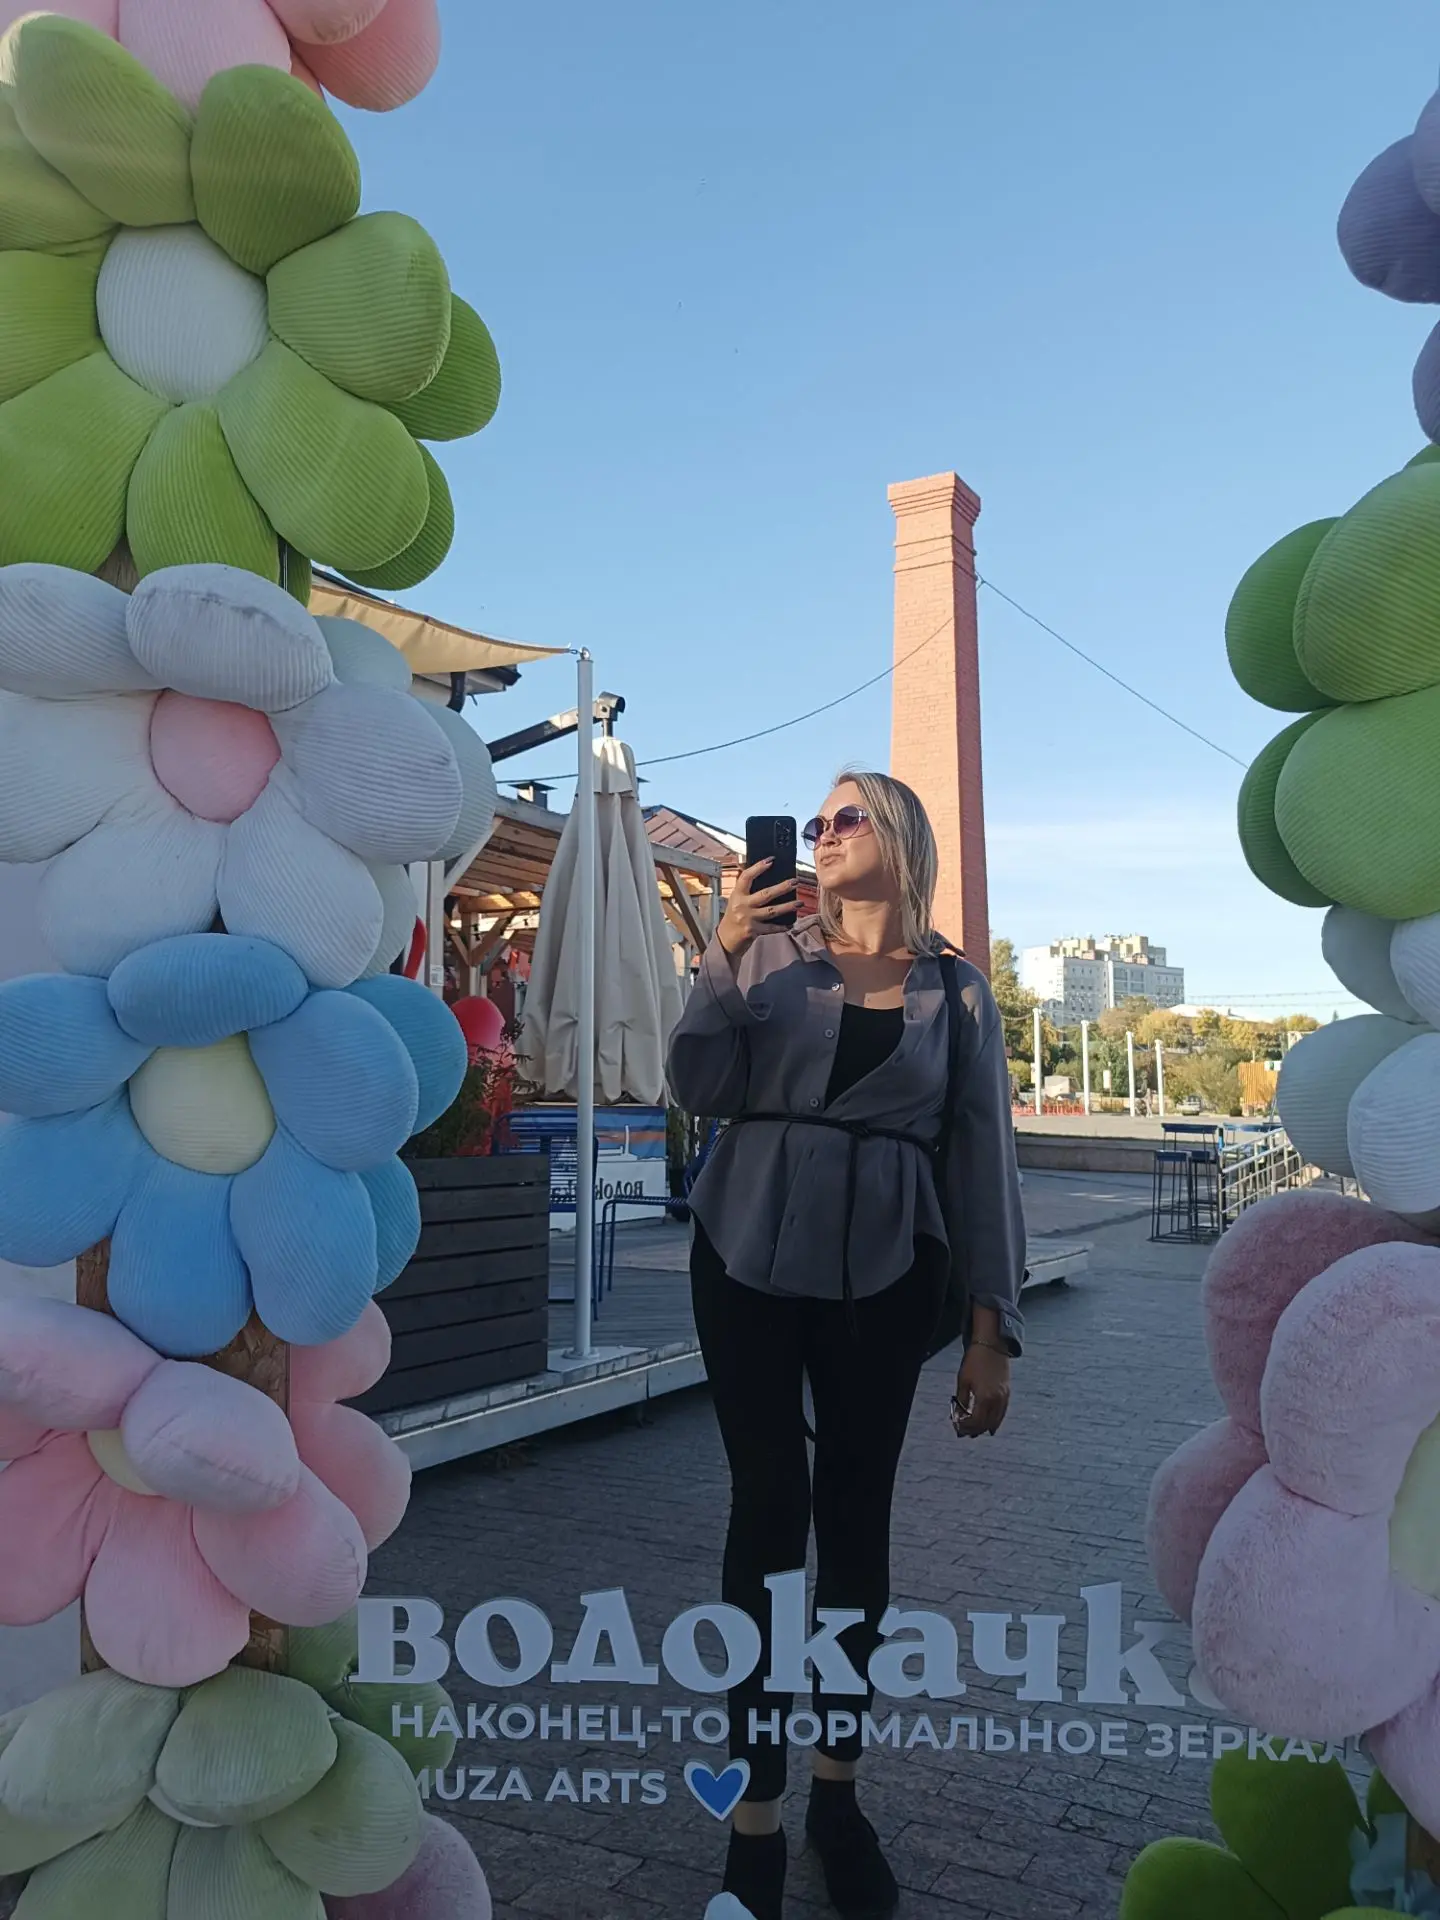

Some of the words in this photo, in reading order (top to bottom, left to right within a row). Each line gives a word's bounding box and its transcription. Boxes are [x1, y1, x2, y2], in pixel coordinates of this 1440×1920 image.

[349, 1568, 1228, 1710] водокачк
[391, 1702, 731, 1749] НАКОНЕЦ-ТО
[747, 1707, 1128, 1756] НОРМАЛЬНОЕ
[1144, 1722, 1361, 1764] ЗЕРКАЛ
[544, 1767, 667, 1804] ARTS
